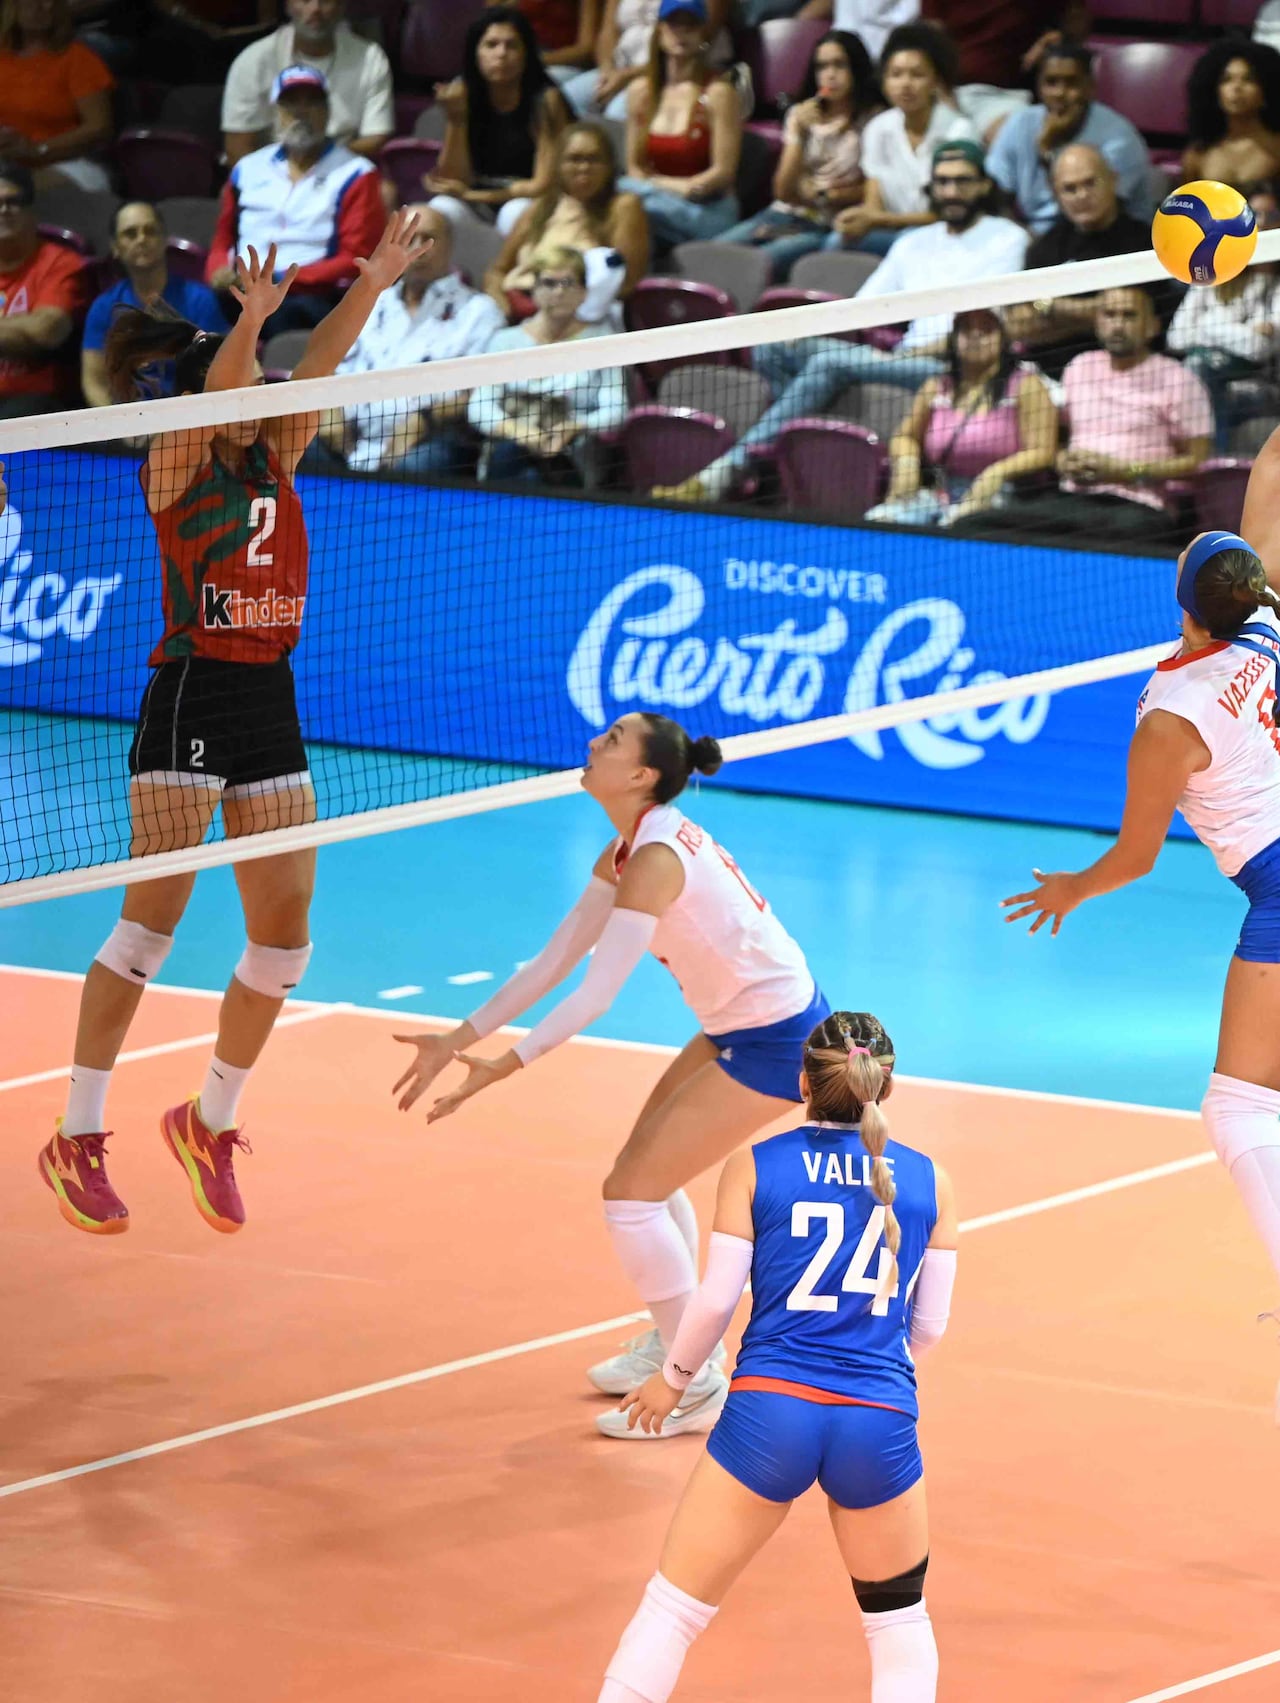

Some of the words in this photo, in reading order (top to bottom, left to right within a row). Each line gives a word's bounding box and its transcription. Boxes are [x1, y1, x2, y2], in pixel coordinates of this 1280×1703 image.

[246, 497, 277, 567] 2
[724, 558, 887, 603] DISCOVER
[567, 564, 849, 728] Puerto
[843, 597, 1064, 770] Rico
[190, 739, 205, 767] 2
[786, 1201, 899, 1317] 24
